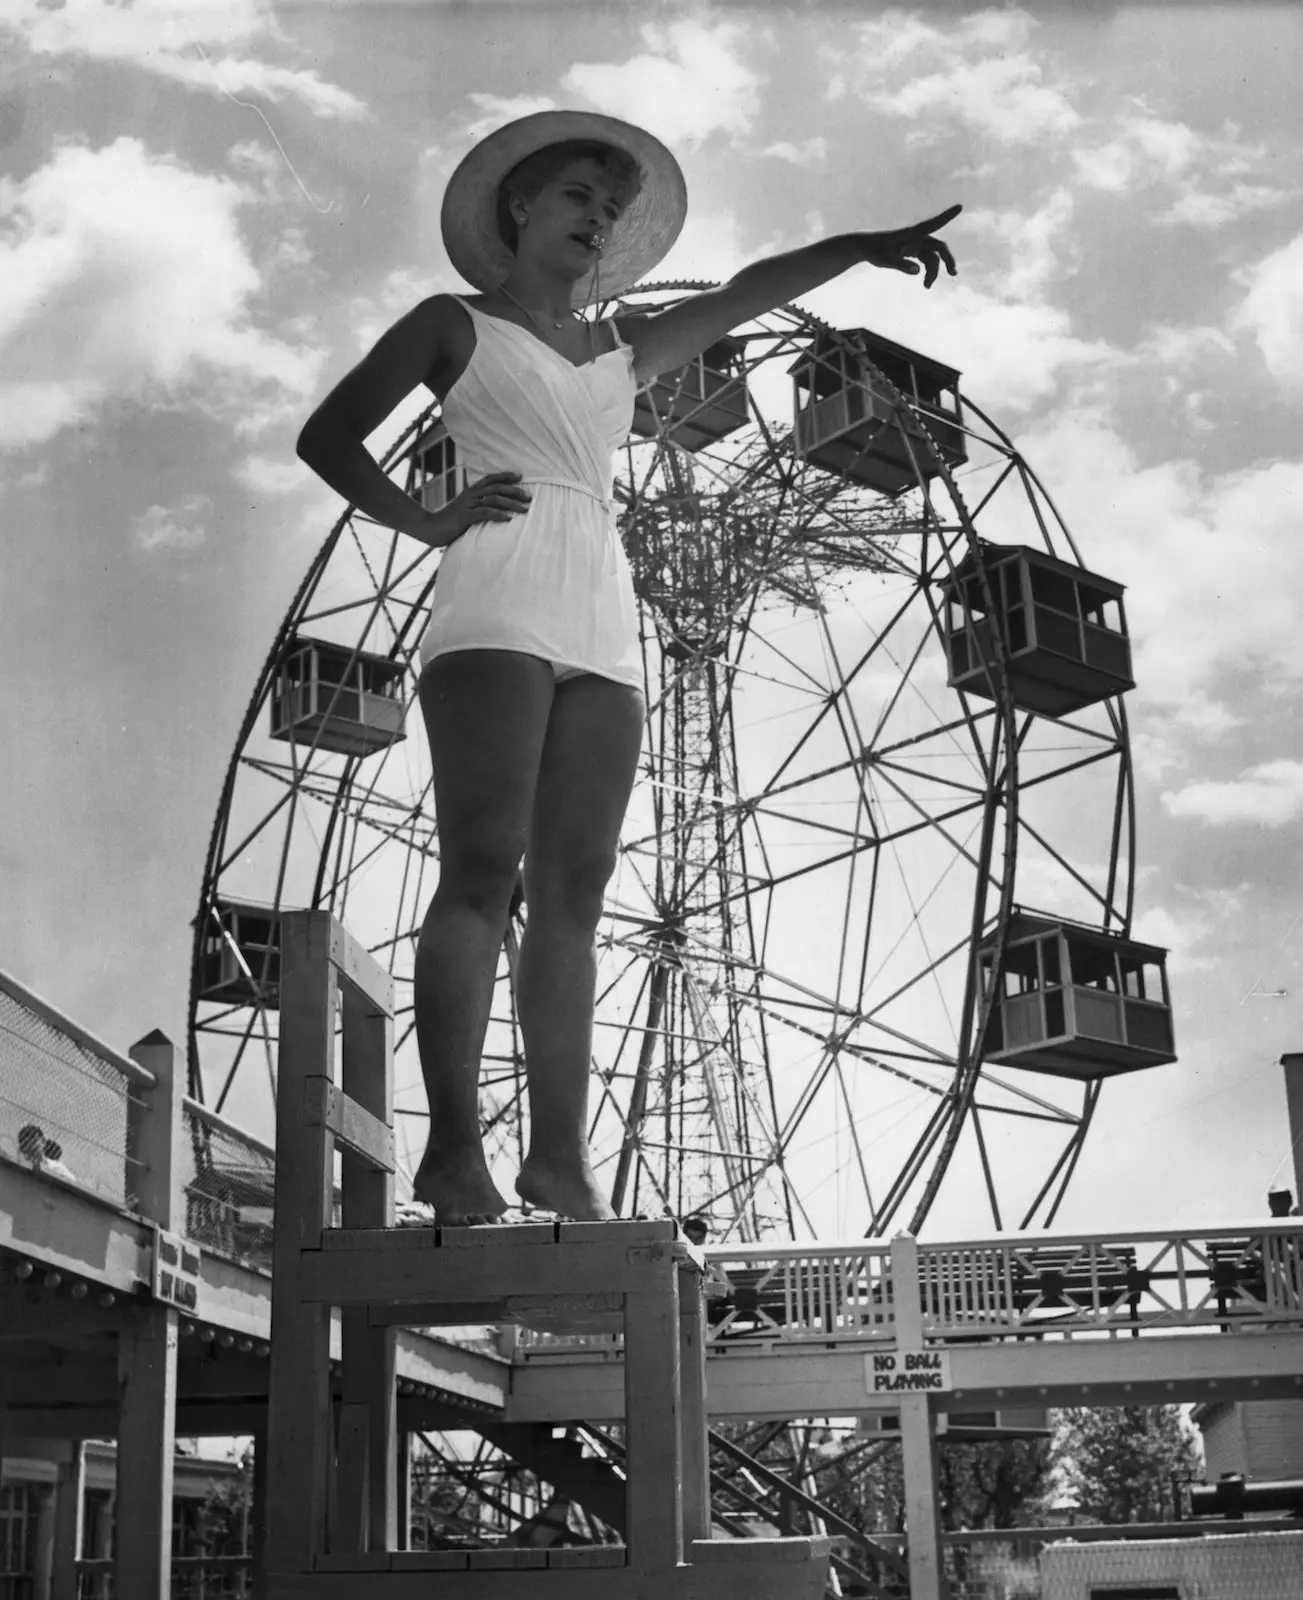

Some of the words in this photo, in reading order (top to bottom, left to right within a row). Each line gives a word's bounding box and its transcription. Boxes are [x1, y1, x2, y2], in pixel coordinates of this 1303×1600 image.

[873, 1355, 896, 1371] NO
[905, 1353, 942, 1370] BALL
[874, 1373, 943, 1390] PLAYING
